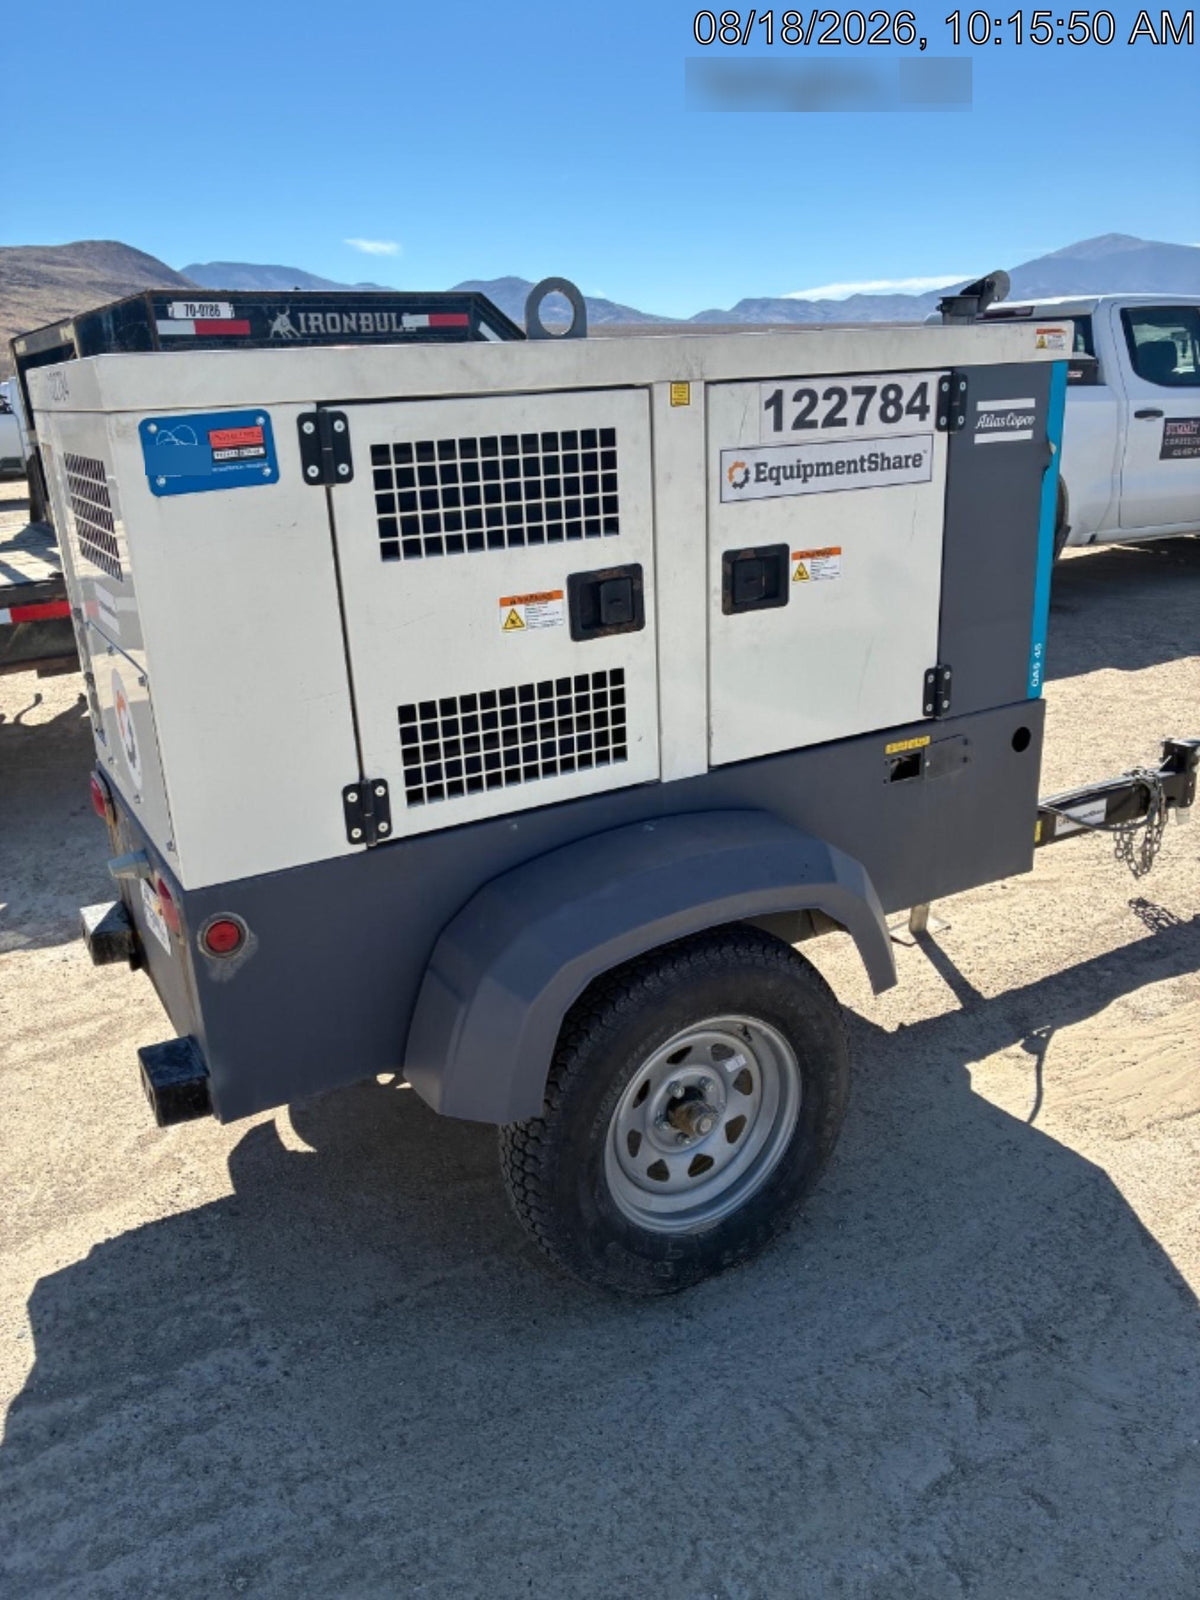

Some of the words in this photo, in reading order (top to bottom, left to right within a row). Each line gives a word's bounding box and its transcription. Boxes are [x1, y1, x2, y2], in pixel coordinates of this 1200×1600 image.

[764, 382, 930, 432] 122784
[975, 413, 1005, 430] Atlas
[1006, 411, 1036, 429] Copco
[754, 451, 924, 486] EquipmentShare
